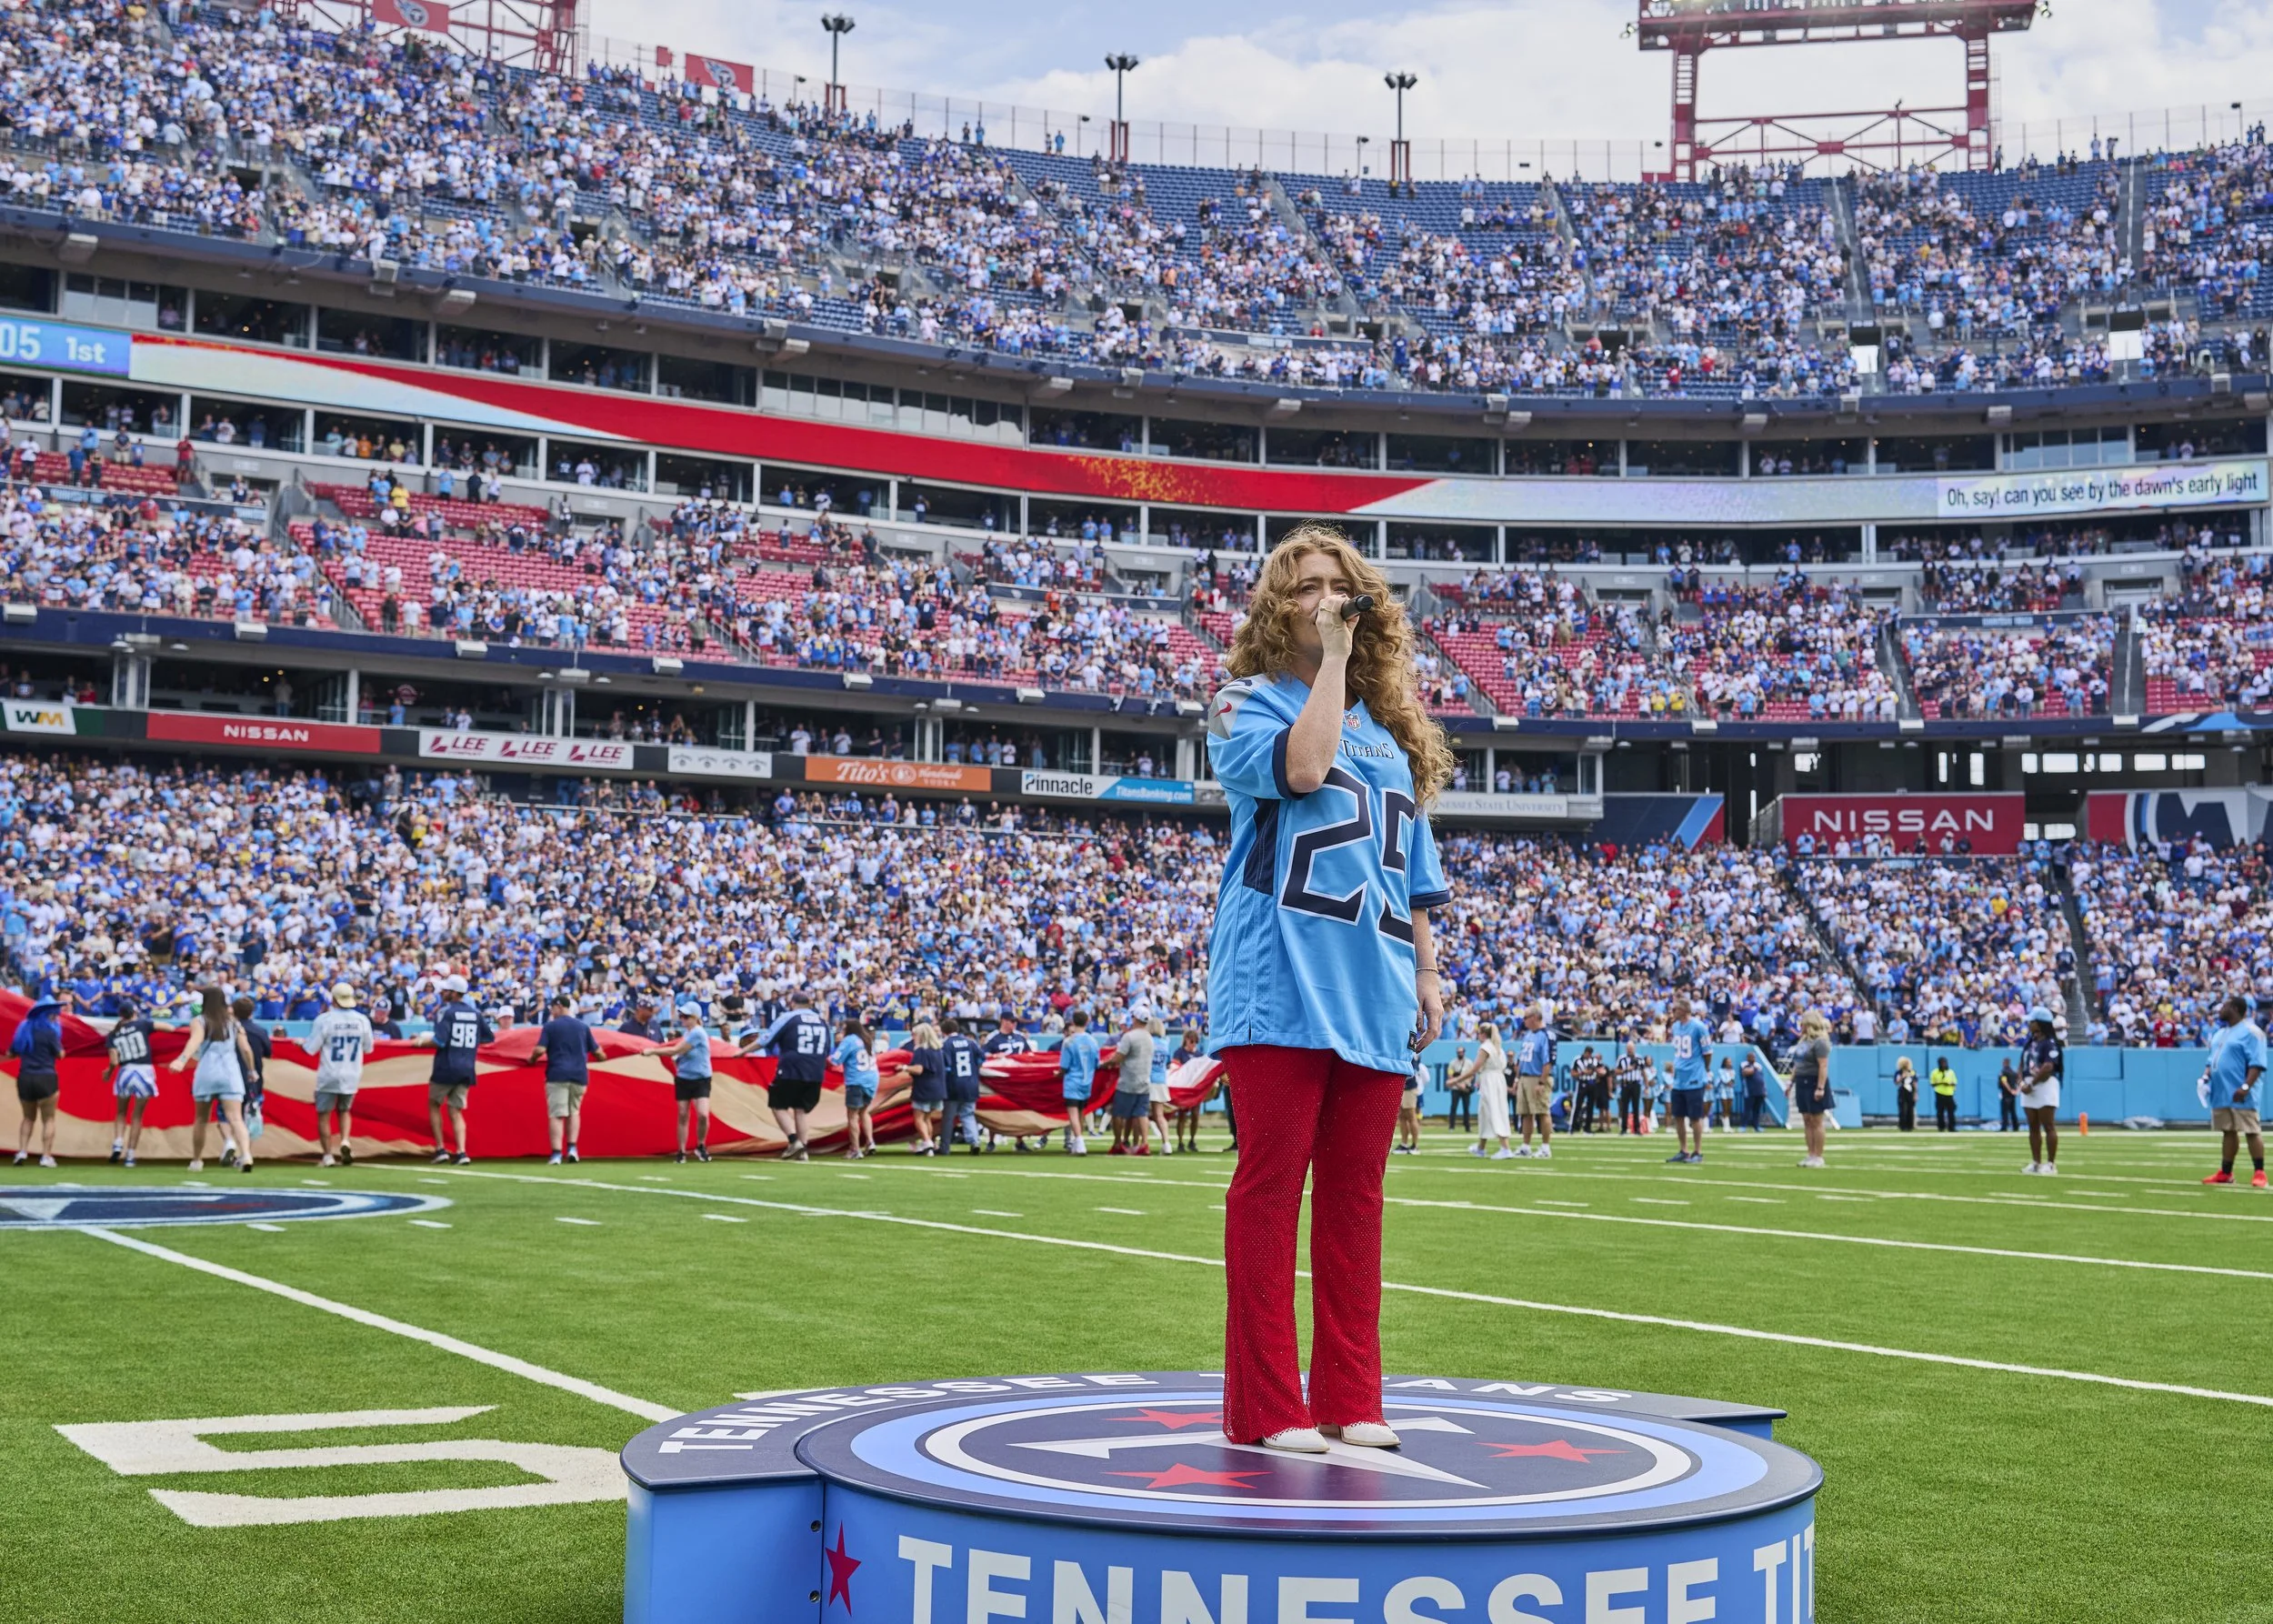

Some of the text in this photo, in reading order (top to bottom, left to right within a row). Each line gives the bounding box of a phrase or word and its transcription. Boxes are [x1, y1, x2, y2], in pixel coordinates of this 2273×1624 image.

[65, 336, 106, 364] 1st
[1947, 487, 1969, 508] Oh,
[2004, 488, 2028, 503] can
[2032, 487, 2057, 506] you
[2060, 486, 2084, 501] see
[2088, 482, 2104, 502] by
[2108, 480, 2130, 499] the
[2134, 476, 2184, 496] dawn's
[2188, 474, 2222, 496] early
[2226, 472, 2258, 493] light
[15, 710, 64, 727] WM
[224, 724, 308, 742] NISSAN
[452, 736, 490, 750] LEE
[521, 741, 558, 755] LEE
[589, 745, 626, 758] LEE
[1340, 738, 1394, 759] TITANS
[836, 760, 890, 783] Tito's
[1025, 774, 1094, 795] Pinnacle
[1814, 808, 1994, 832] NISSAN
[450, 1022, 478, 1049] 98
[796, 1024, 826, 1055] 27
[331, 1036, 361, 1062] 27
[956, 1050, 972, 1077] 8
[657, 1374, 1160, 1454] TENNESSEE
